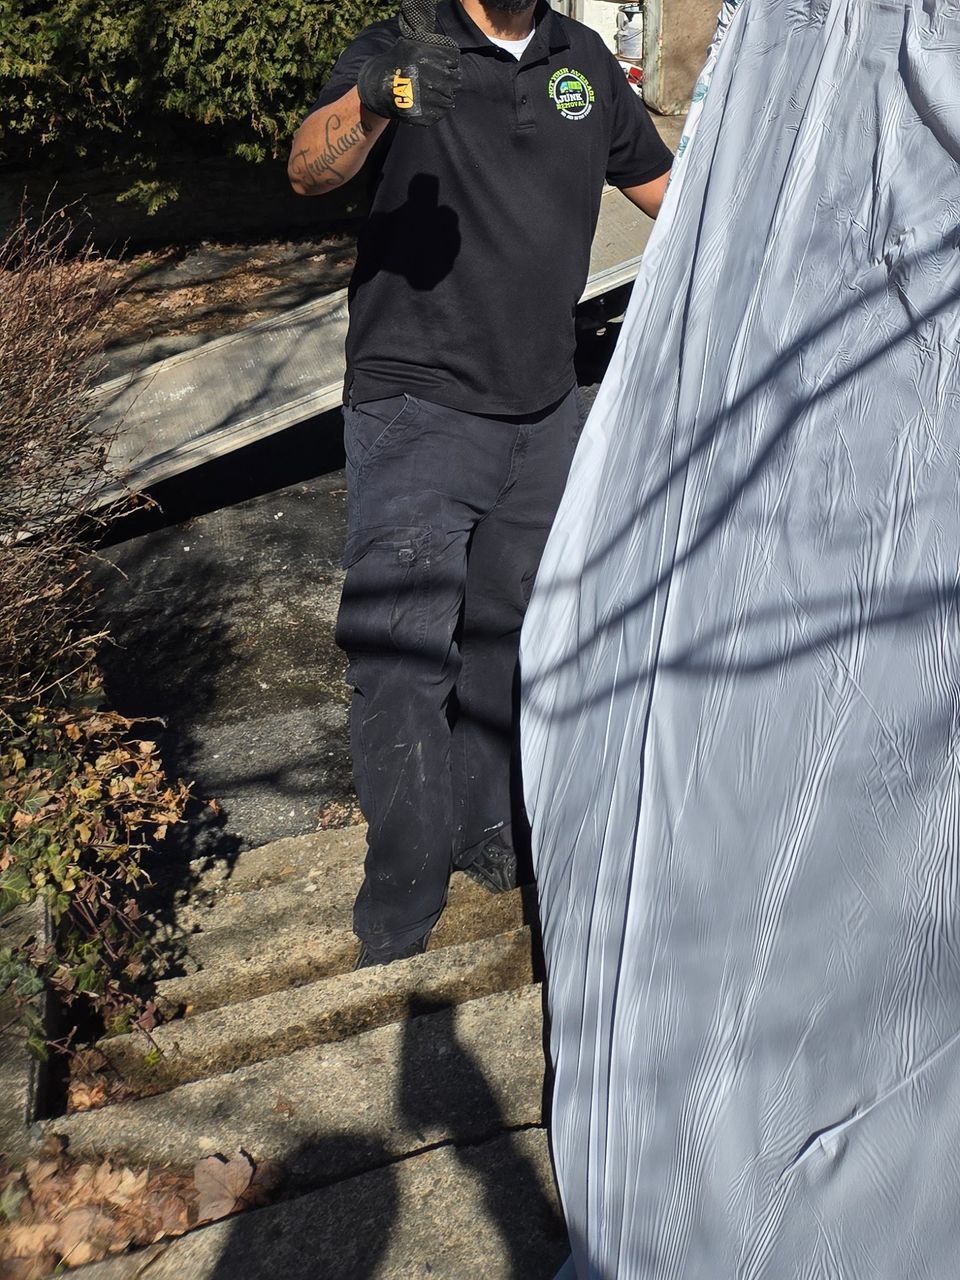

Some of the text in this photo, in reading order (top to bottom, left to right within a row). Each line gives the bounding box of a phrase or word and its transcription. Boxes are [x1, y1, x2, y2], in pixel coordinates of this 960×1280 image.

[393, 75, 414, 109] CAT
[551, 67, 569, 81] YOUR
[571, 69, 595, 102] AVERAGE
[556, 100, 585, 110] REMOVAL
[558, 93, 583, 103] JUNK
